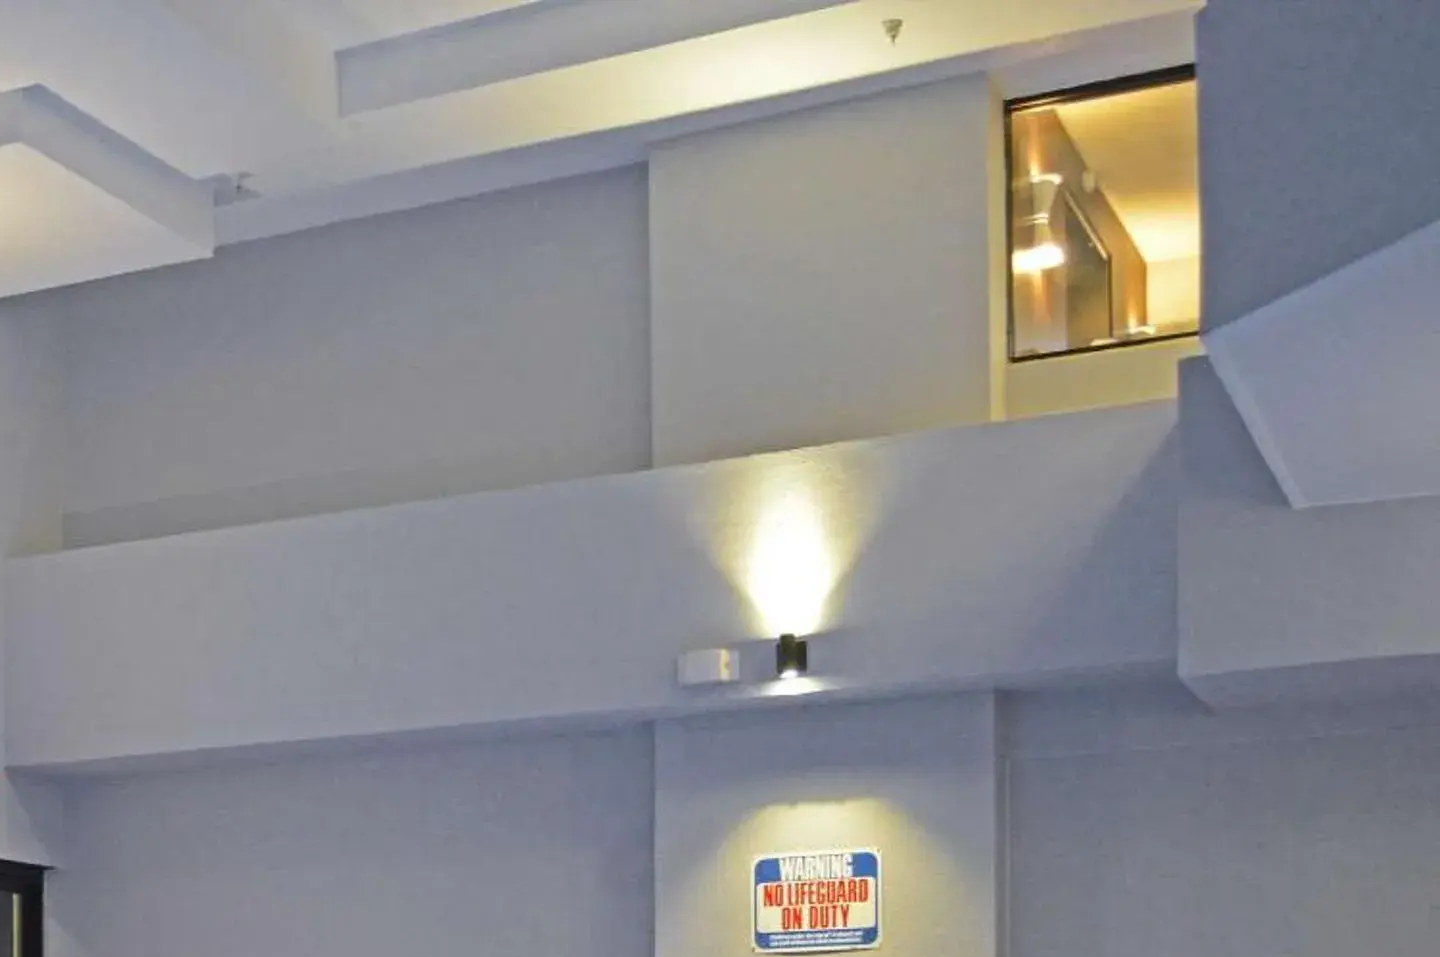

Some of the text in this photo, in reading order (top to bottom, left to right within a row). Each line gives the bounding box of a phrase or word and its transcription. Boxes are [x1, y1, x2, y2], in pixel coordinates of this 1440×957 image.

[779, 853, 853, 881] WARNING
[763, 879, 868, 907] NO LIFEGUARD
[782, 905, 850, 930] ON DUTY
